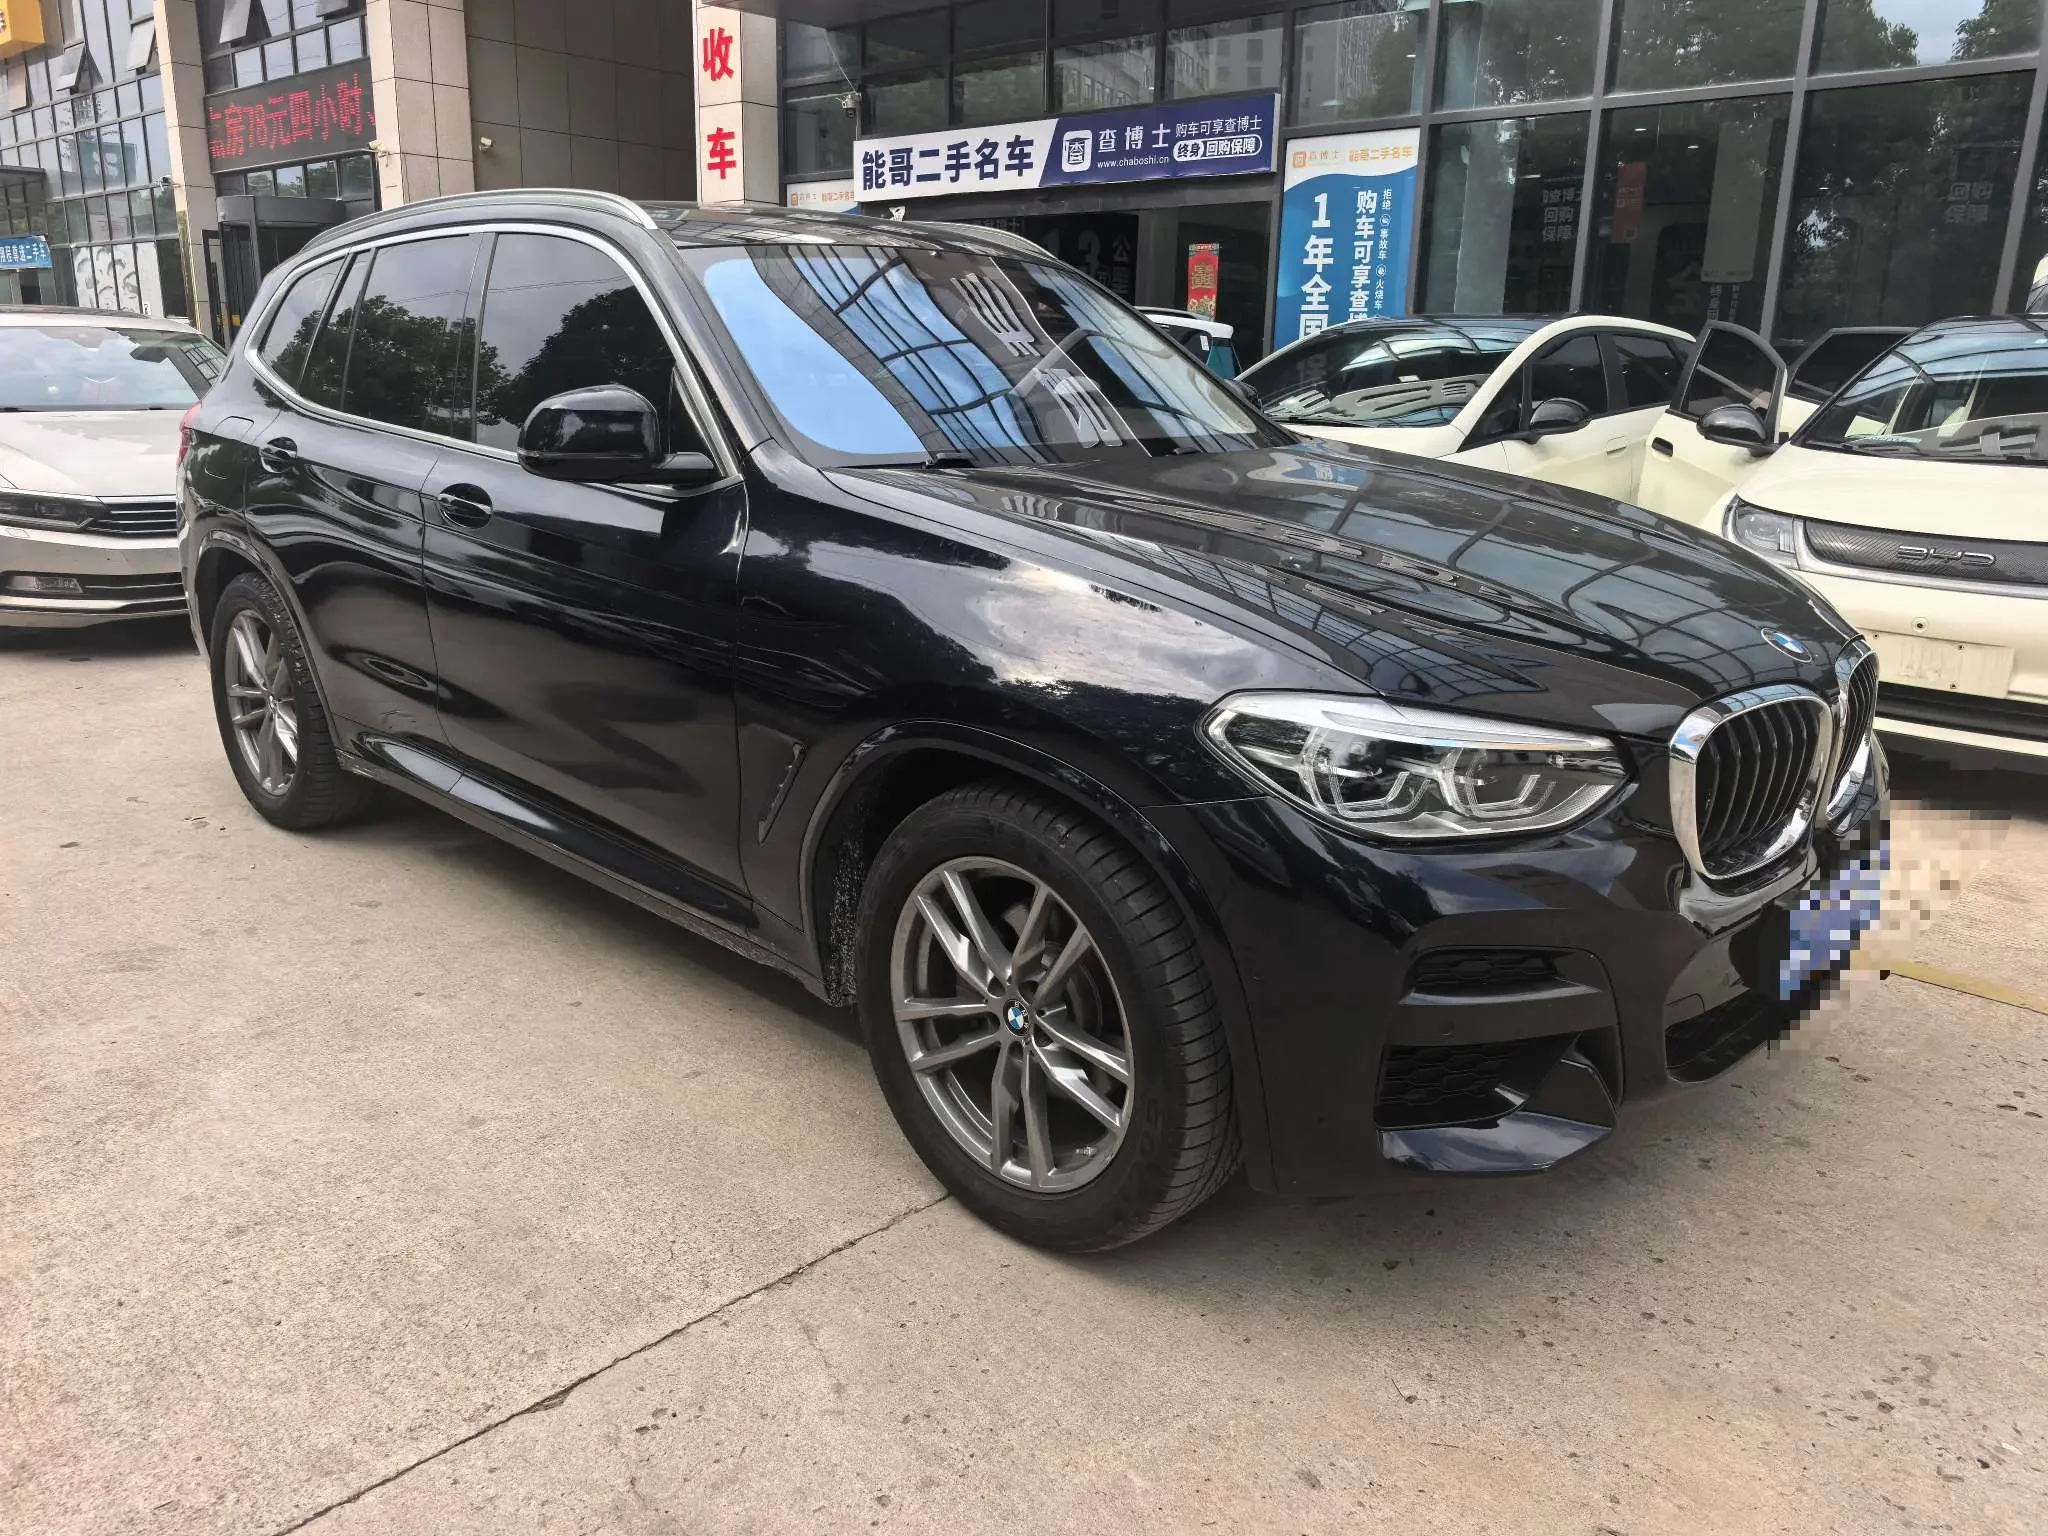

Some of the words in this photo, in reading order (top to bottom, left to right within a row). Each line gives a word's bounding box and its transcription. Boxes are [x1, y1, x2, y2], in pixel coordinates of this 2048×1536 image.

[703, 27, 737, 180] 收车
[1098, 123, 1171, 153] 查博士
[1175, 115, 1263, 138] 购车可享查博士
[1177, 143, 1202, 159] 终身
[1206, 138, 1256, 156] 回购保障
[862, 135, 1034, 191] 能哥二手名车
[1097, 155, 1170, 168] www.chaboshi.cn
[1897, 546, 1997, 567] BYD
